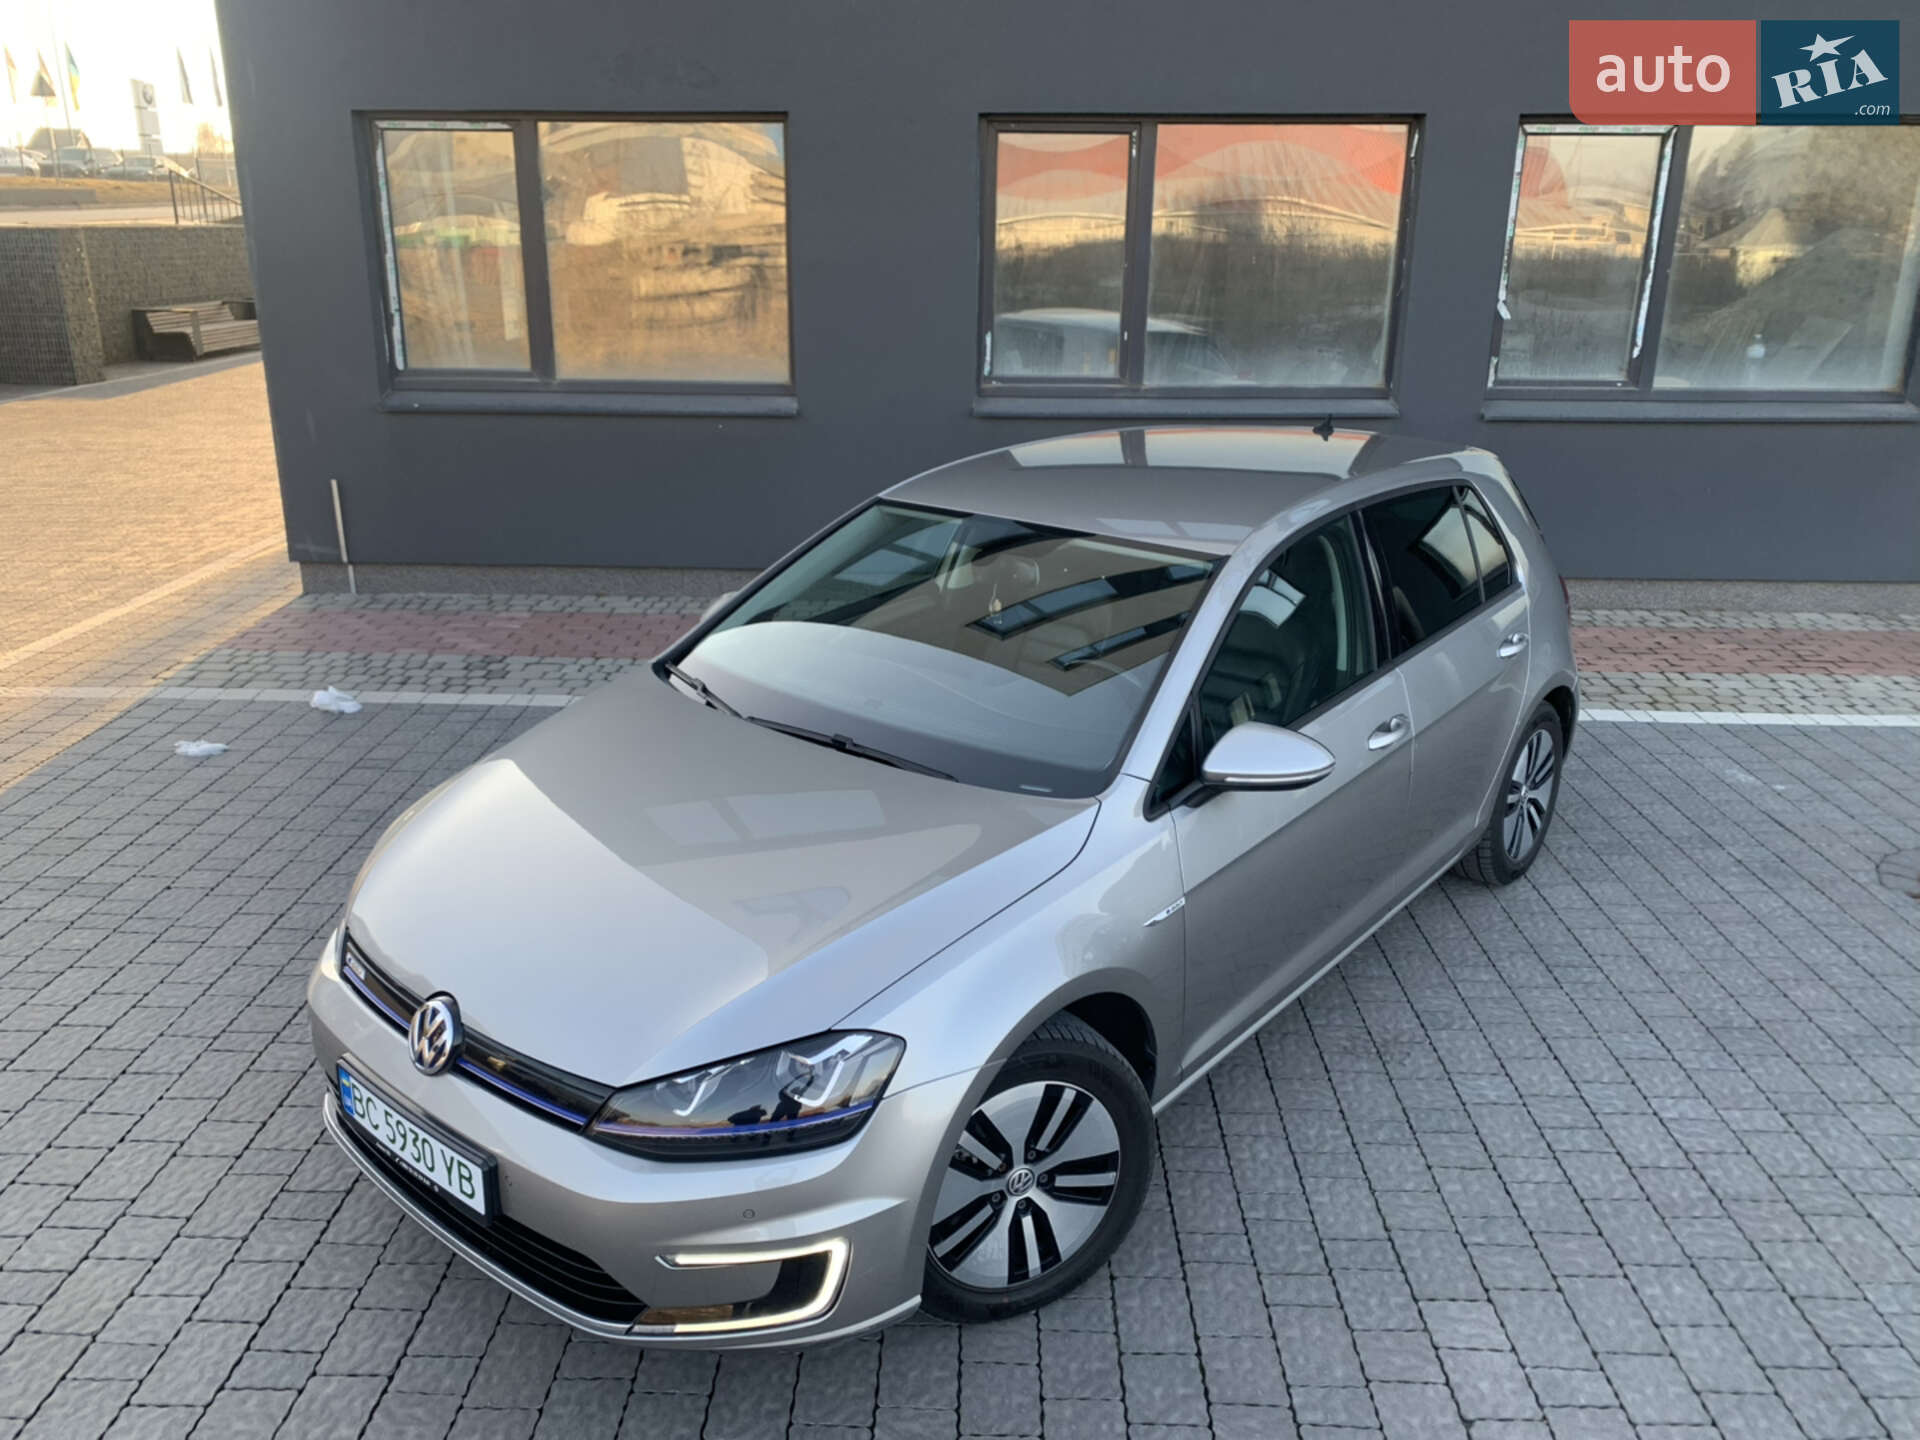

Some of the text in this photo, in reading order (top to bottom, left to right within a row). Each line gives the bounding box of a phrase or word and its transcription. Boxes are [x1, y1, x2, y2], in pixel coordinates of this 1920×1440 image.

[351, 1083, 380, 1131] BC
[384, 1109, 435, 1174] 5930
[440, 1149, 476, 1200] YB
